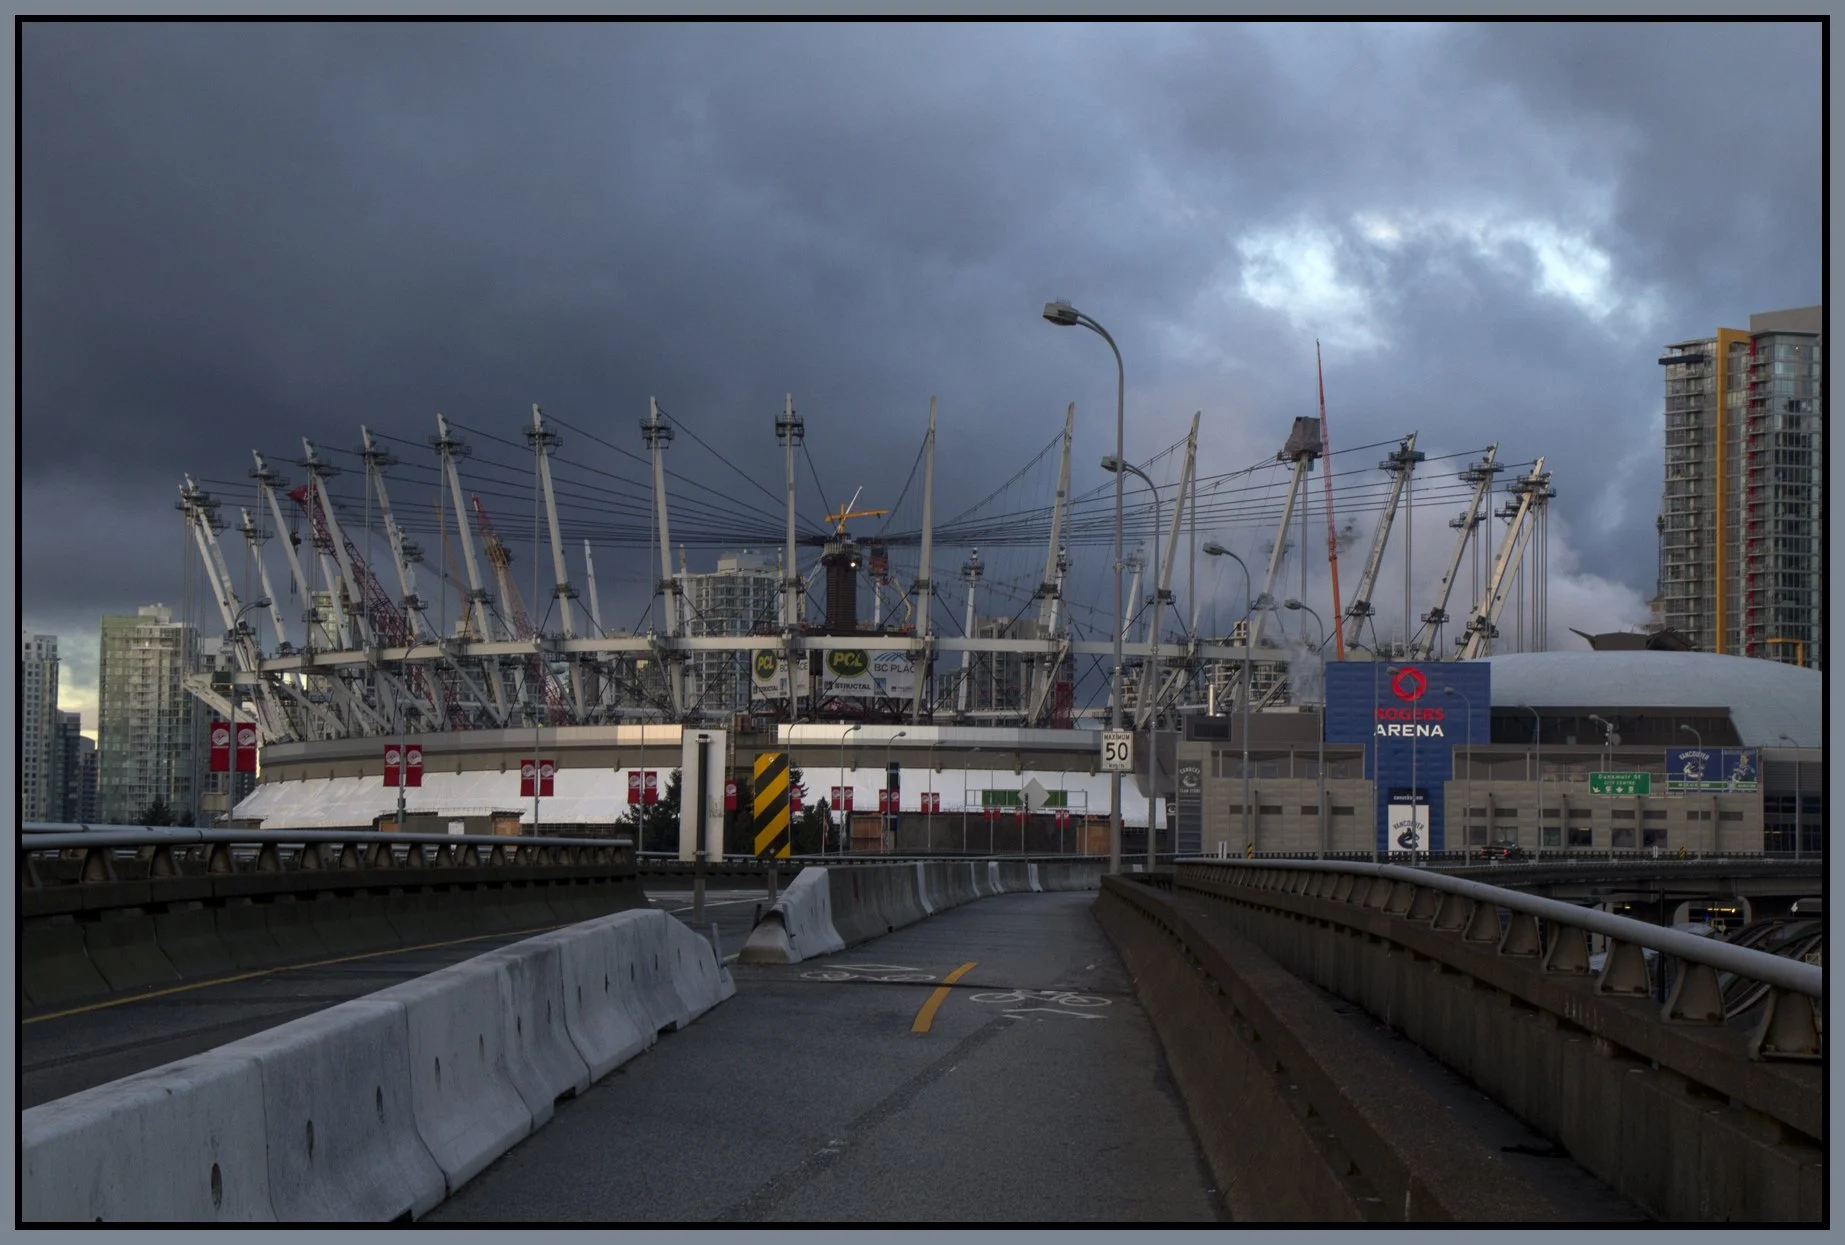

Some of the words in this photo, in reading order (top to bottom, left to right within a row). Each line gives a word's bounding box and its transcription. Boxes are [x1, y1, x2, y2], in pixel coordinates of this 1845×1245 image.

[758, 655, 775, 670] PCL
[833, 652, 863, 667] PCL
[874, 663, 889, 672] BC
[890, 664, 915, 673] PLAC
[834, 682, 871, 690] STRUCTAL
[1374, 707, 1445, 721] ROGERS
[1373, 724, 1444, 737] ARENA
[1105, 742, 1128, 761] 50
